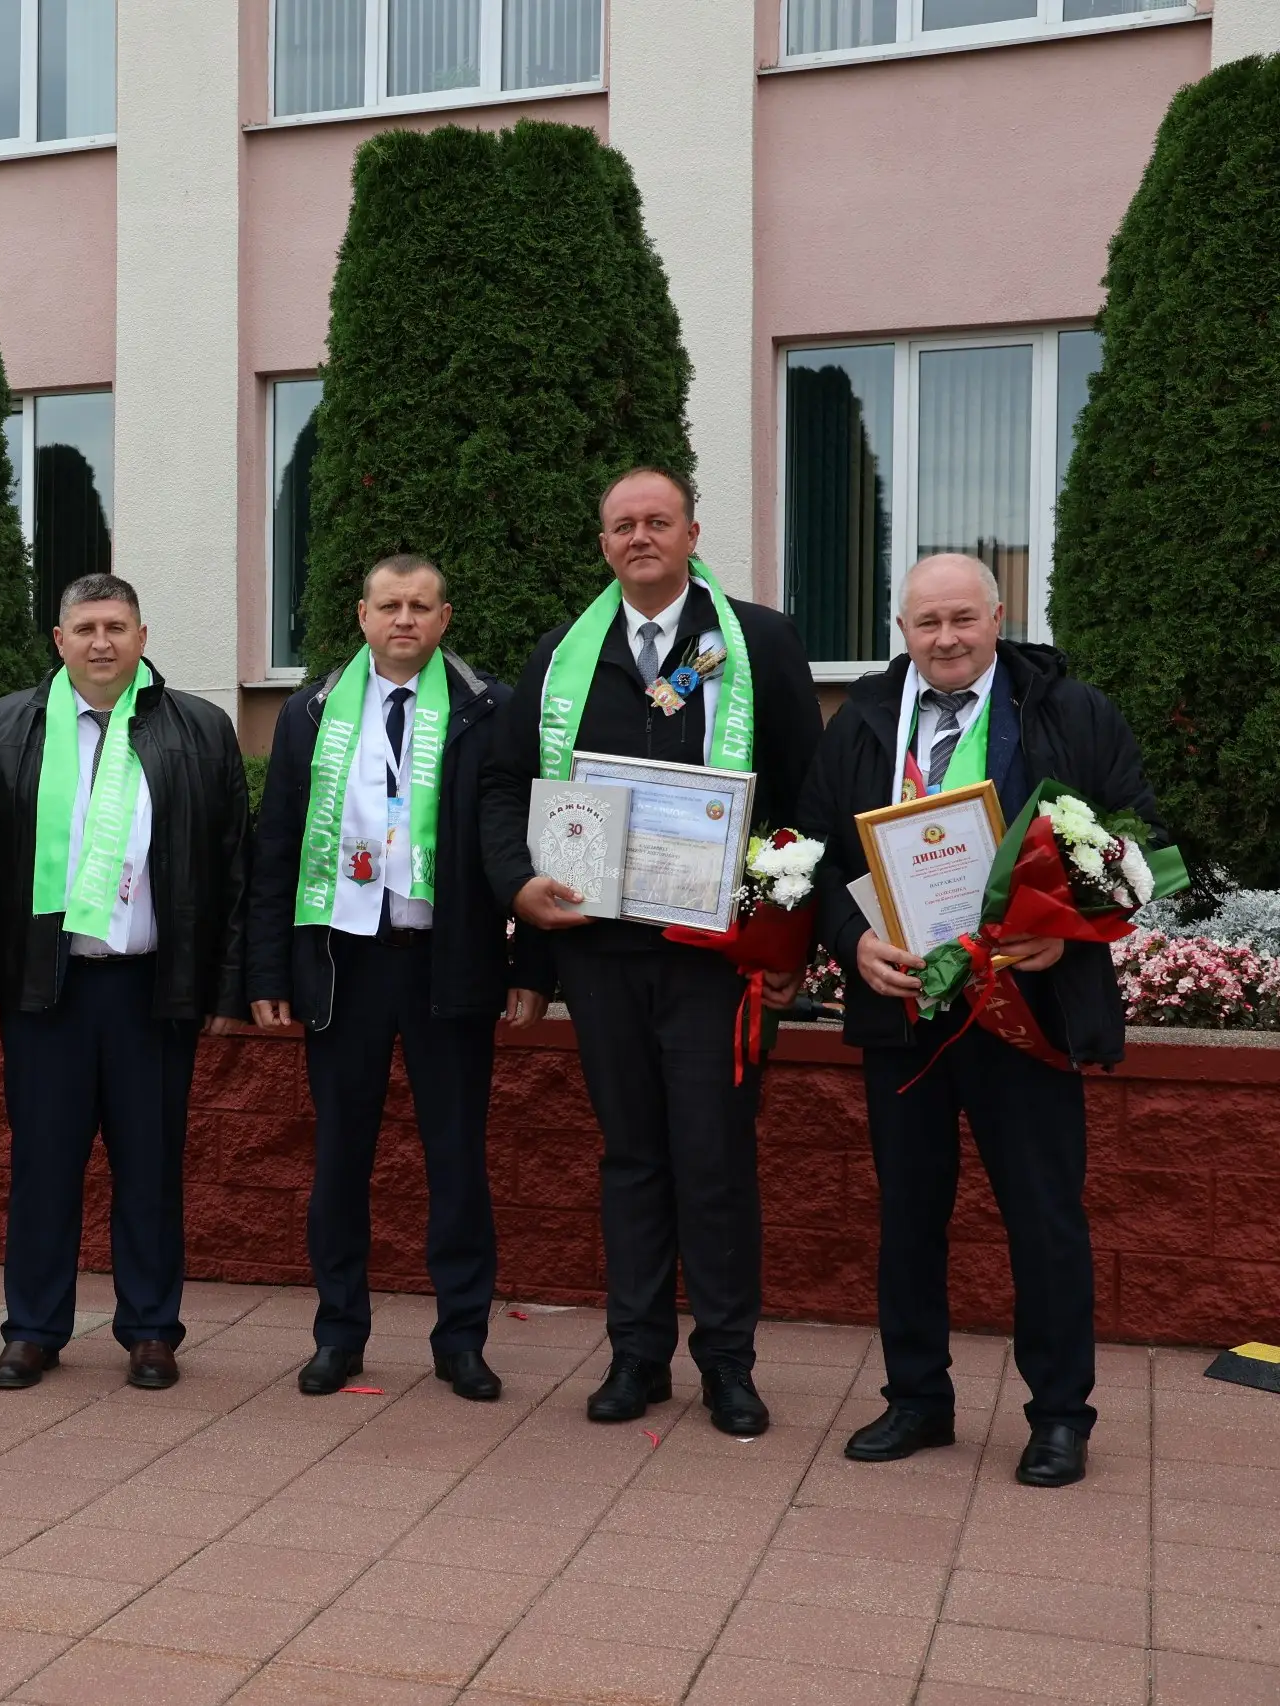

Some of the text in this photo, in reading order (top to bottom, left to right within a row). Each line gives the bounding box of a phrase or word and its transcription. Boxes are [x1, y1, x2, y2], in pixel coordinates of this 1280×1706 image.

[411, 707, 445, 789] РАЙОН
[304, 716, 355, 910] БЕРЕСТОВИЦКИЙ
[548, 803, 604, 823] ДАЖЫНКІ
[566, 823, 583, 838] 30
[912, 843, 968, 867] ДИПЛОМ
